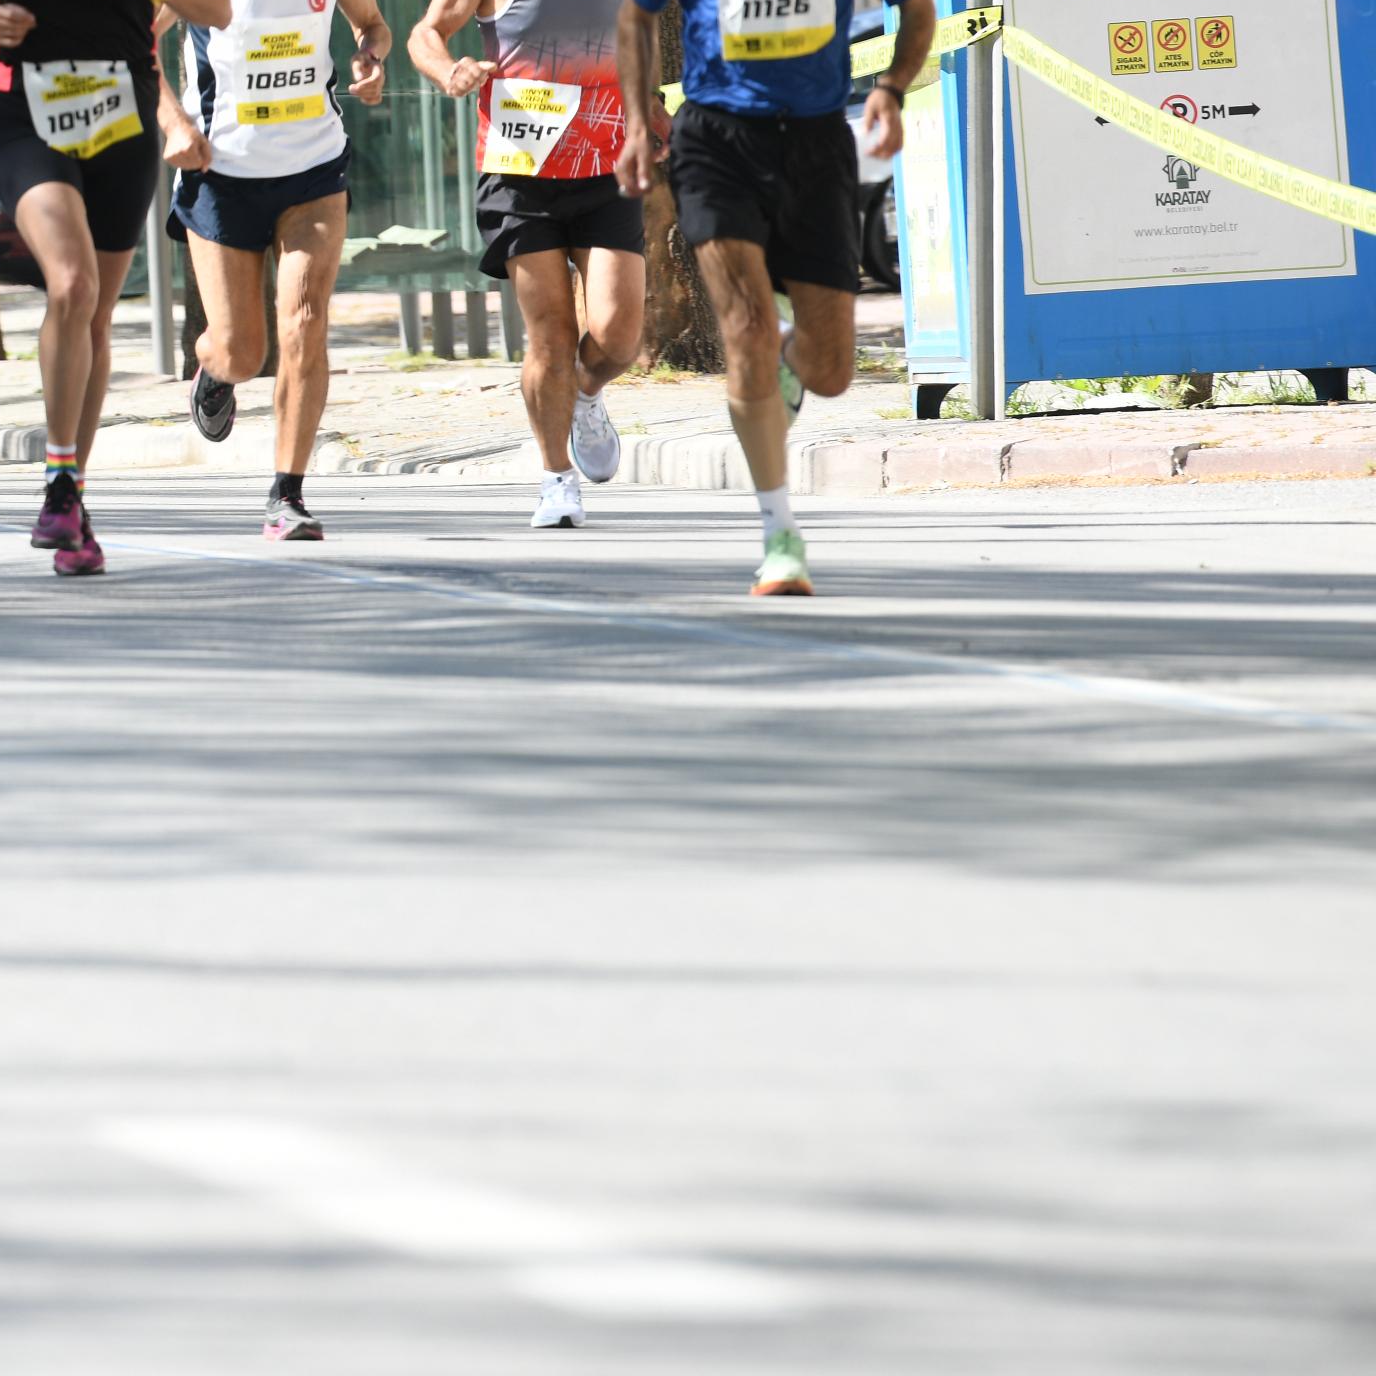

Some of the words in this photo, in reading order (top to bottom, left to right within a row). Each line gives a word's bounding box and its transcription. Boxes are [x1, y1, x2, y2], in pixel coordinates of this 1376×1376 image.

[246, 67, 316, 90] 10863
[46, 94, 121, 135] 10499
[1201, 104, 1226, 120] 5M
[1155, 189, 1211, 207] KARATAY
[1134, 222, 1239, 239] www.karatay.bel.tr
